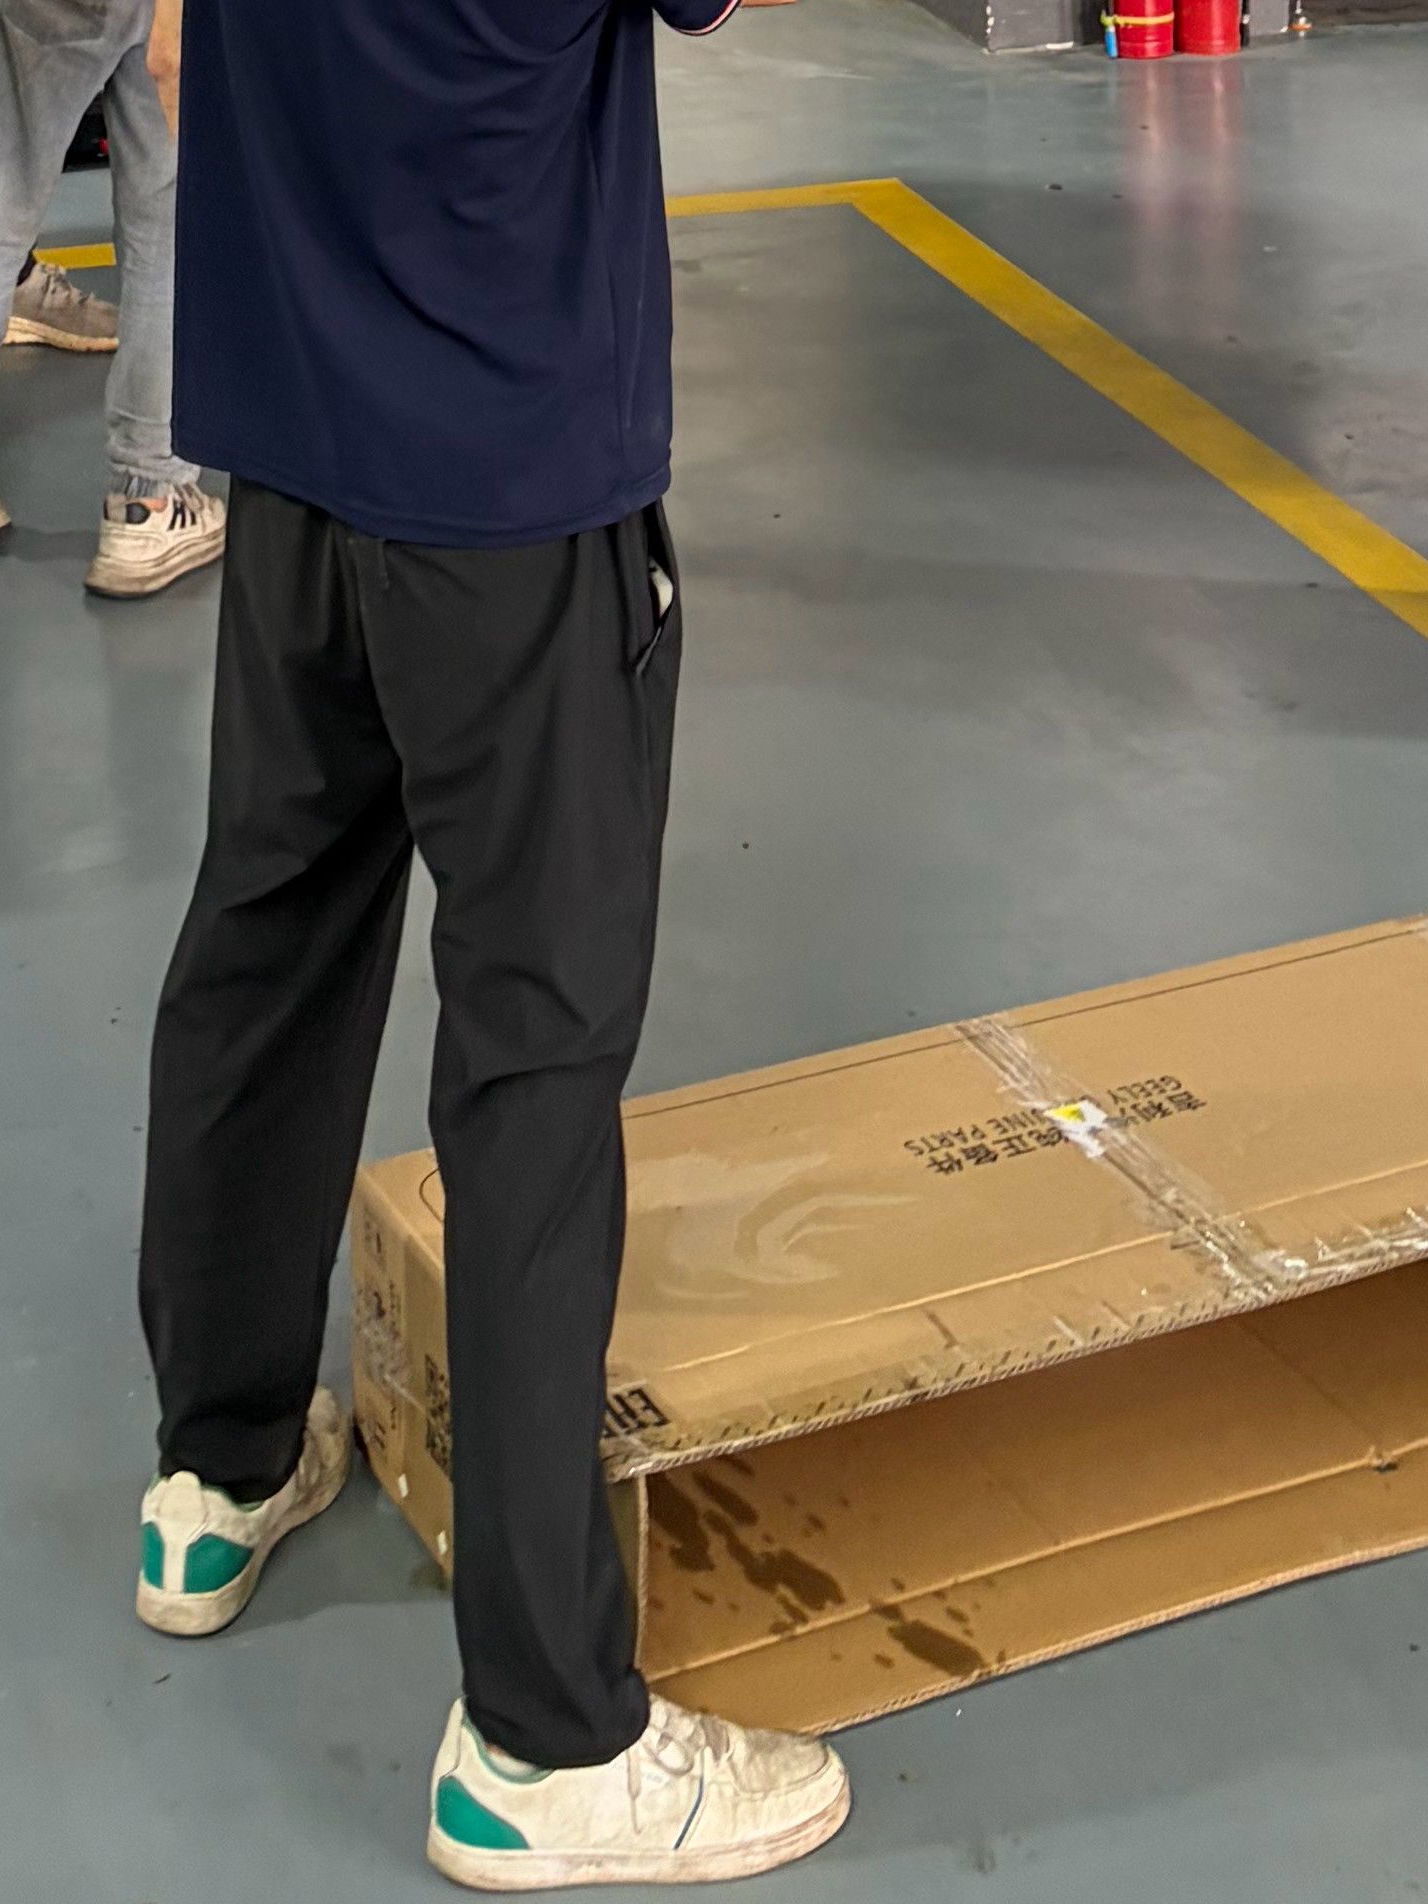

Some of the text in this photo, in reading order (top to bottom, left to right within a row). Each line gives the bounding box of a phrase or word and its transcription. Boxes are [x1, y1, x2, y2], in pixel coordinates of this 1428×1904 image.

[1106, 1075, 1182, 1104] GEELY
[903, 1122, 987, 1157] PARTS
[926, 1090, 1207, 1175] 吉利纯正备件
